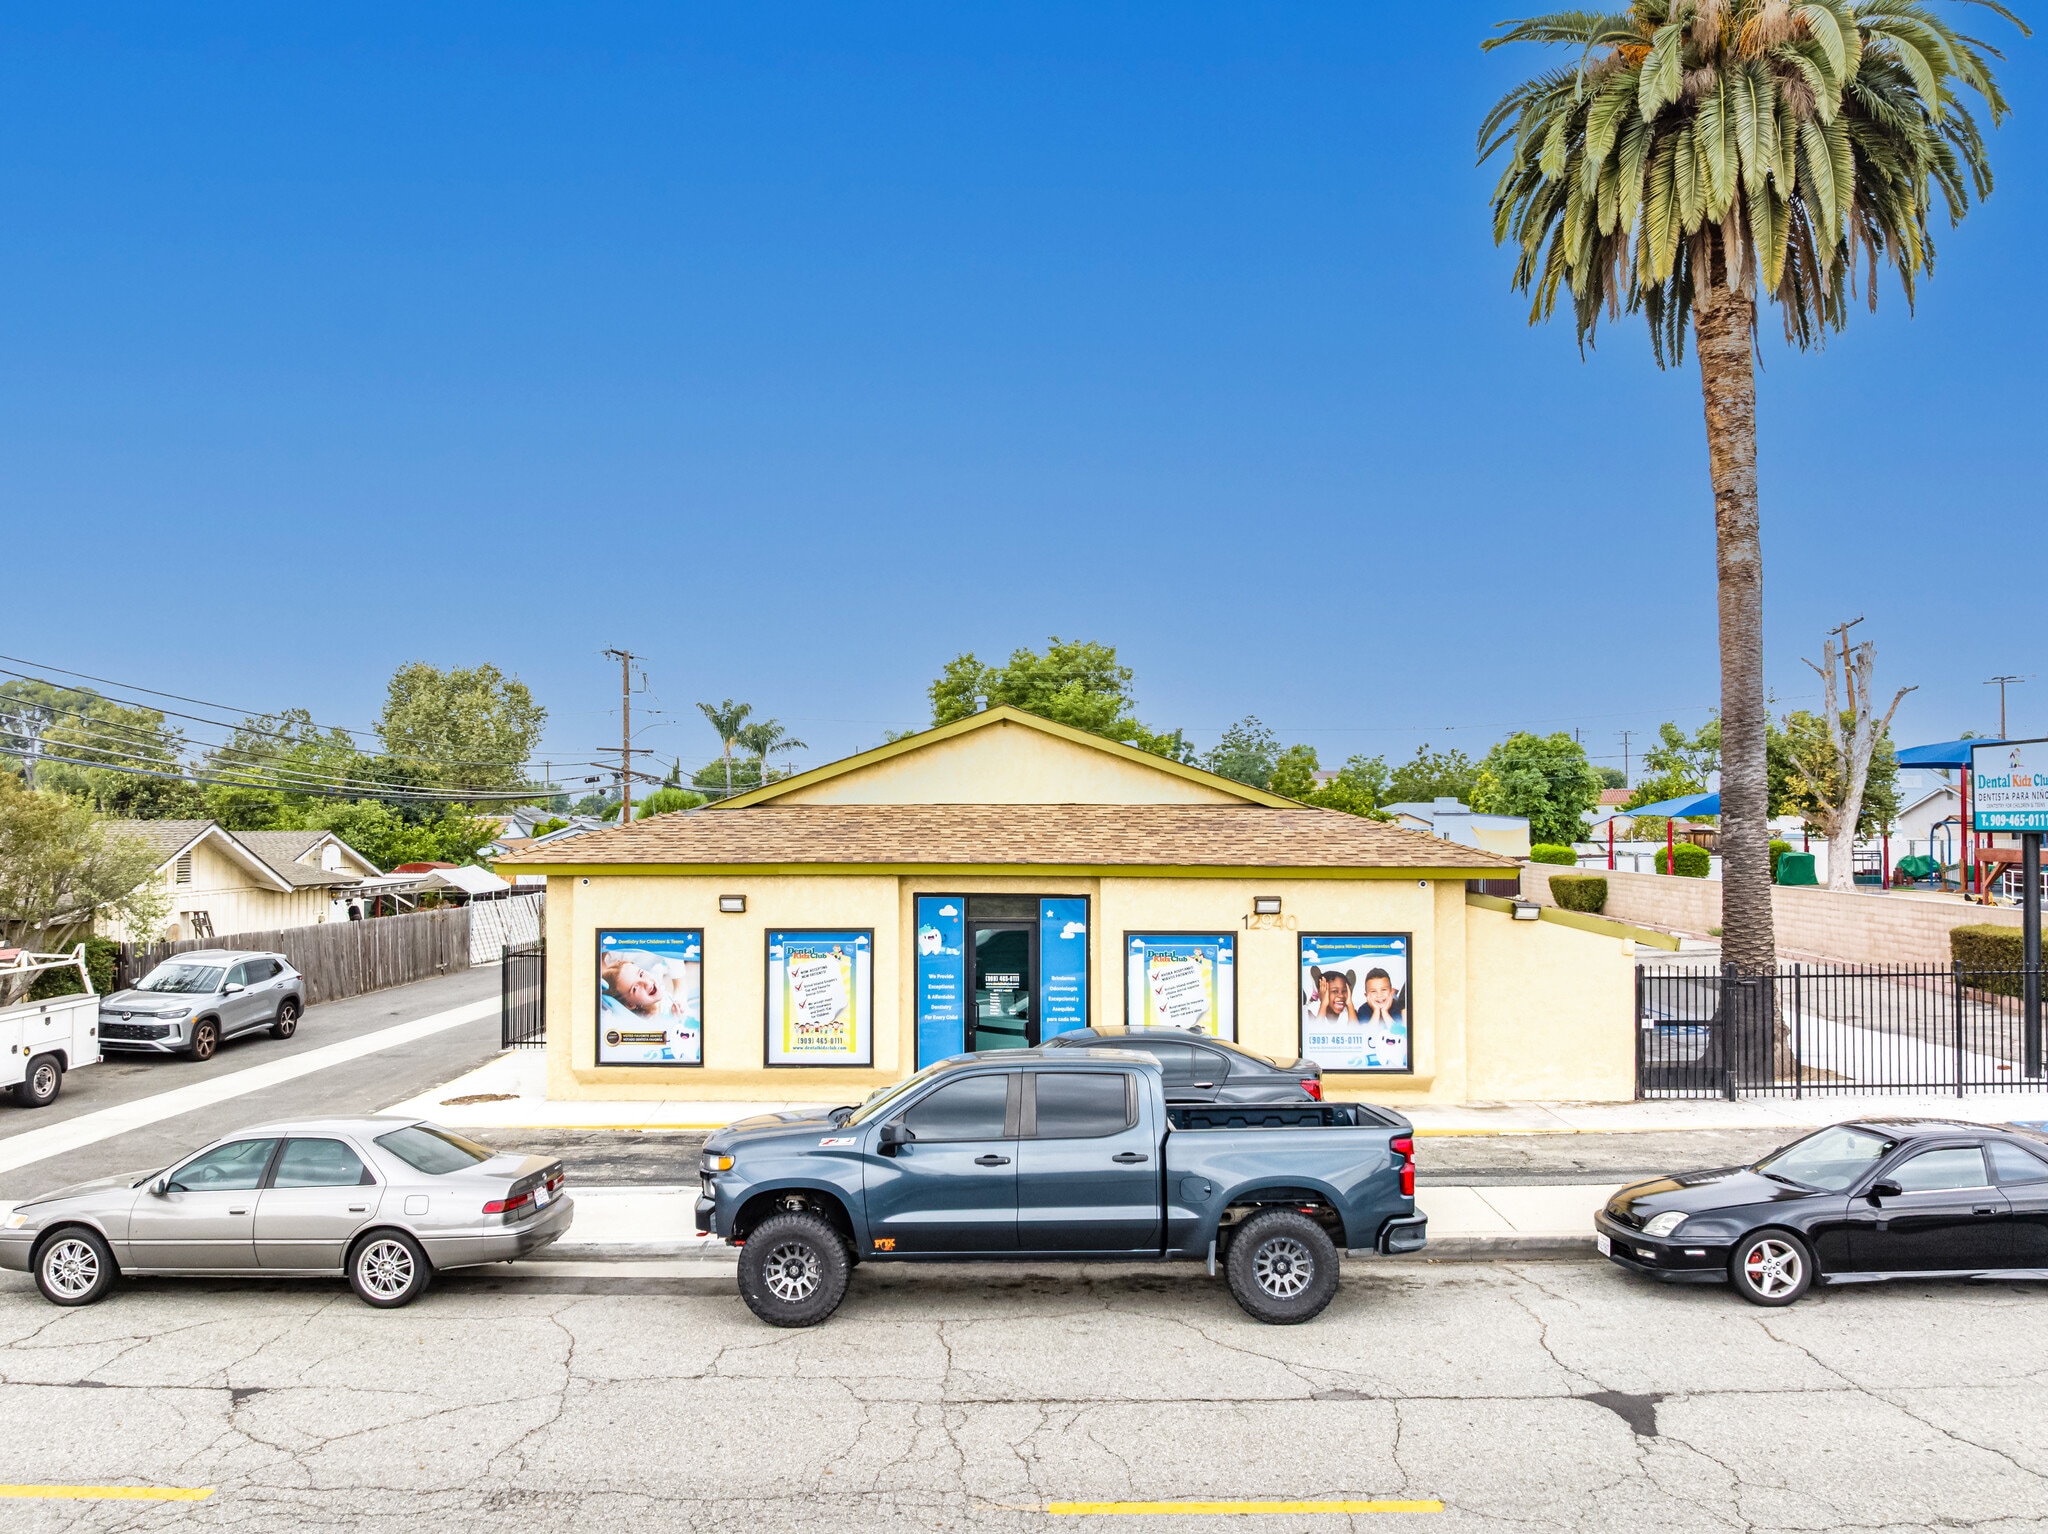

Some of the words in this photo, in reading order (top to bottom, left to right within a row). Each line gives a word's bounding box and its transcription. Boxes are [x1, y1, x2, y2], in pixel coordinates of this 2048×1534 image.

[1978, 774, 2010, 788] Dental
[2012, 774, 2032, 787] Kidz
[1979, 793, 2009, 801] DENTISTA
[2012, 792, 2029, 800] PARA
[1981, 814, 1989, 826] T.
[874, 1238, 896, 1250] FOX
